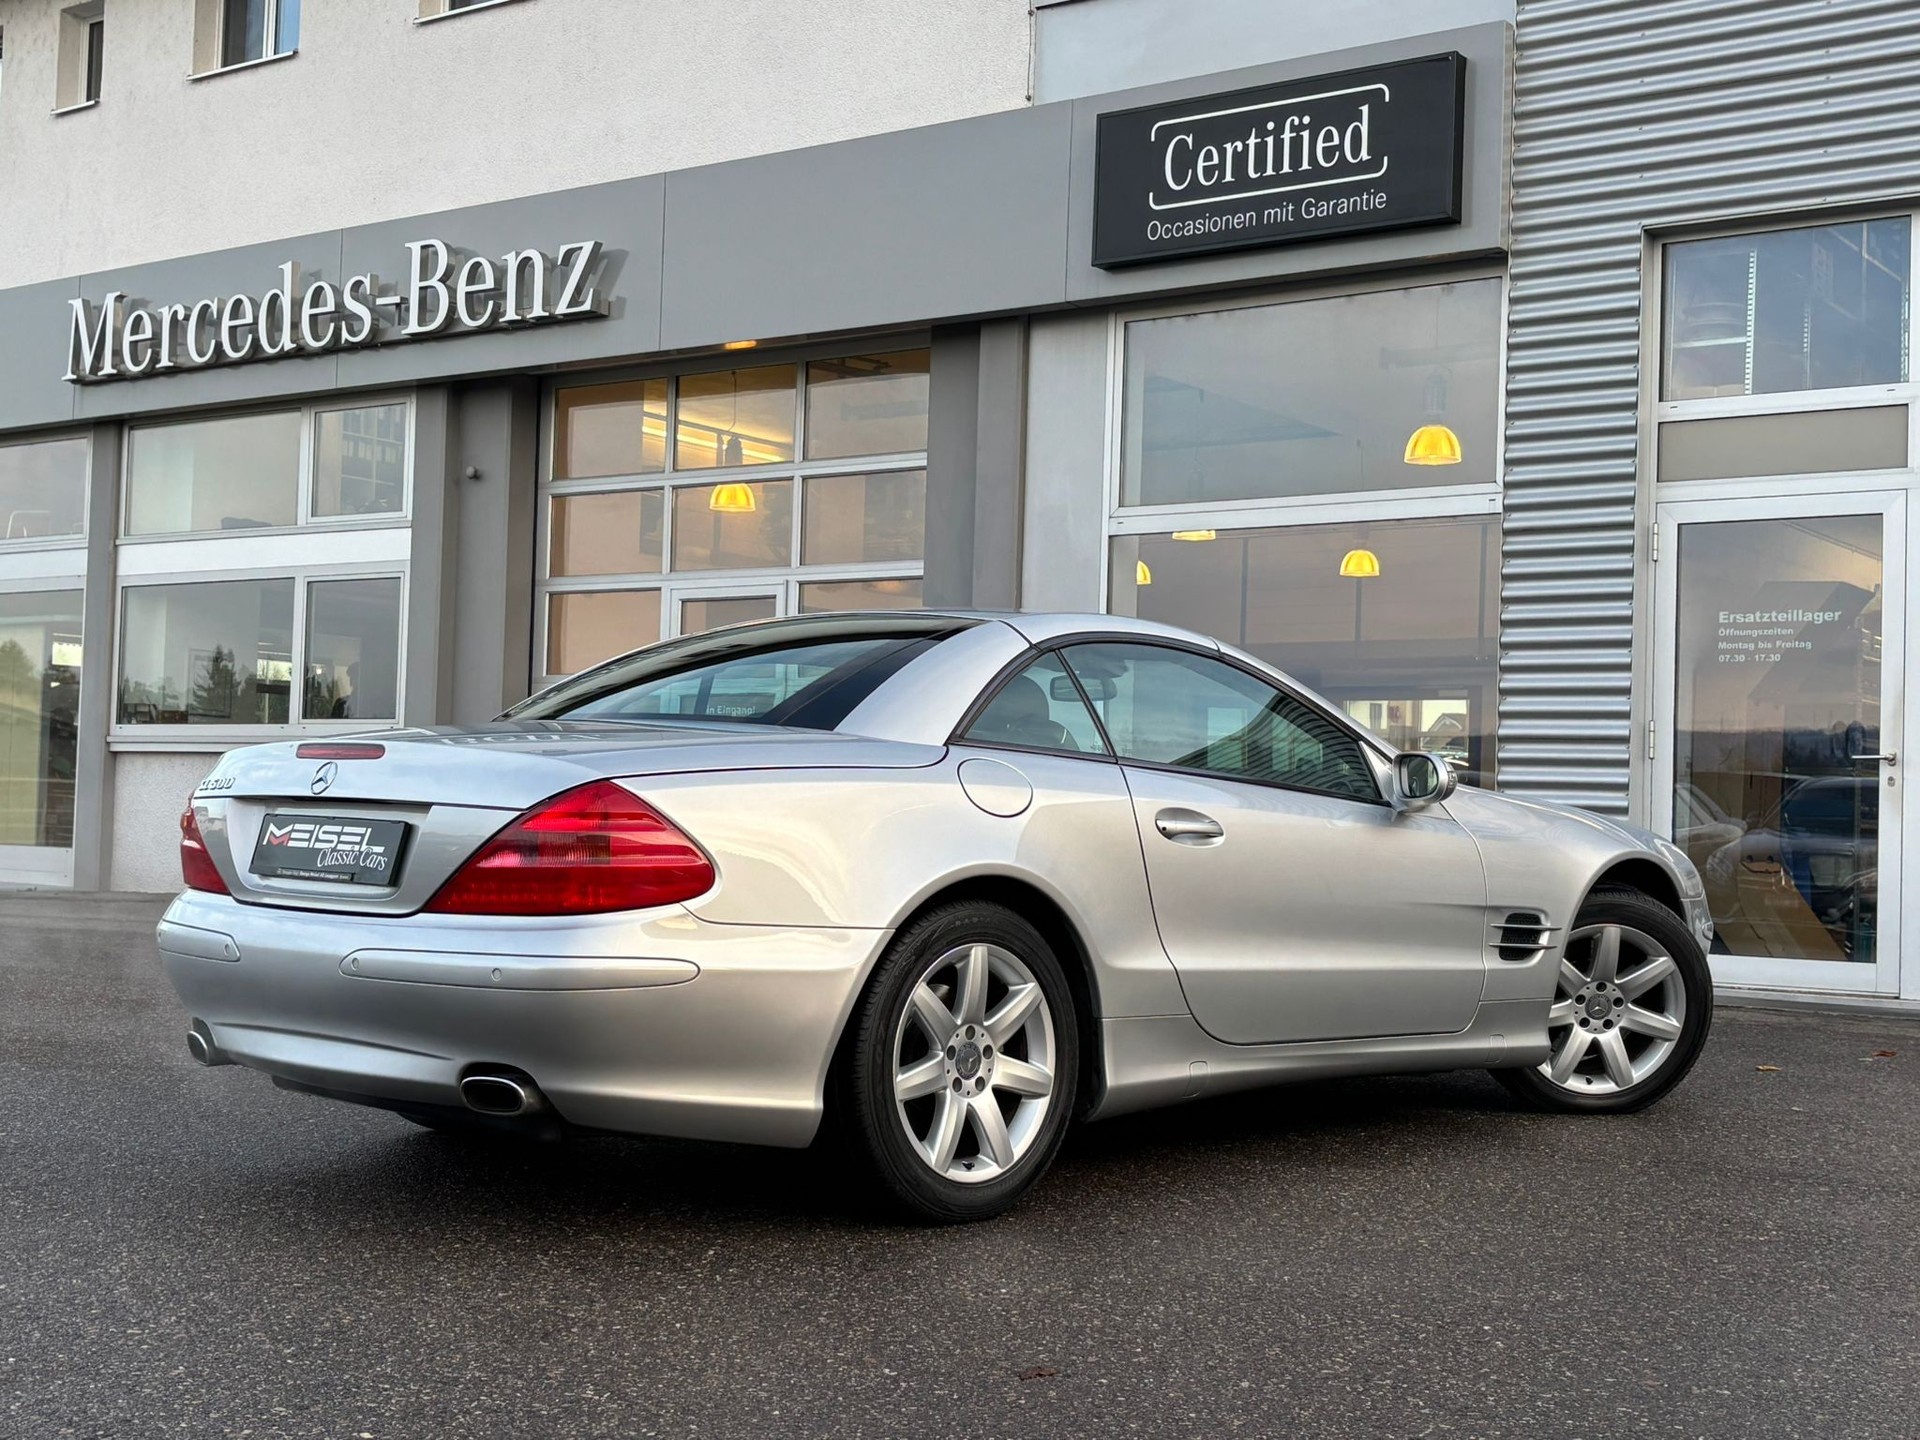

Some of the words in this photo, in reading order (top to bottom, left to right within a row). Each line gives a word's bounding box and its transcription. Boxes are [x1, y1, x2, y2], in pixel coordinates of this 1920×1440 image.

[1163, 103, 1372, 191] Certified
[1146, 210, 1257, 241] Occasionen
[1263, 201, 1294, 224] mit
[1301, 188, 1387, 218] Garantie
[61, 238, 607, 383] Mercedes-Benz
[1718, 609, 1842, 624] Ersatzteillager
[1718, 627, 1794, 637] Öffnungszeiten
[1718, 641, 1755, 651] Montag
[1758, 641, 1772, 649] bis
[1775, 640, 1812, 650] Freitag
[1718, 654, 1746, 662] 07.30
[1754, 653, 1781, 662] 17.30
[262, 822, 386, 853] MEISEL
[317, 845, 359, 868] Classic
[359, 847, 388, 871] Cars
